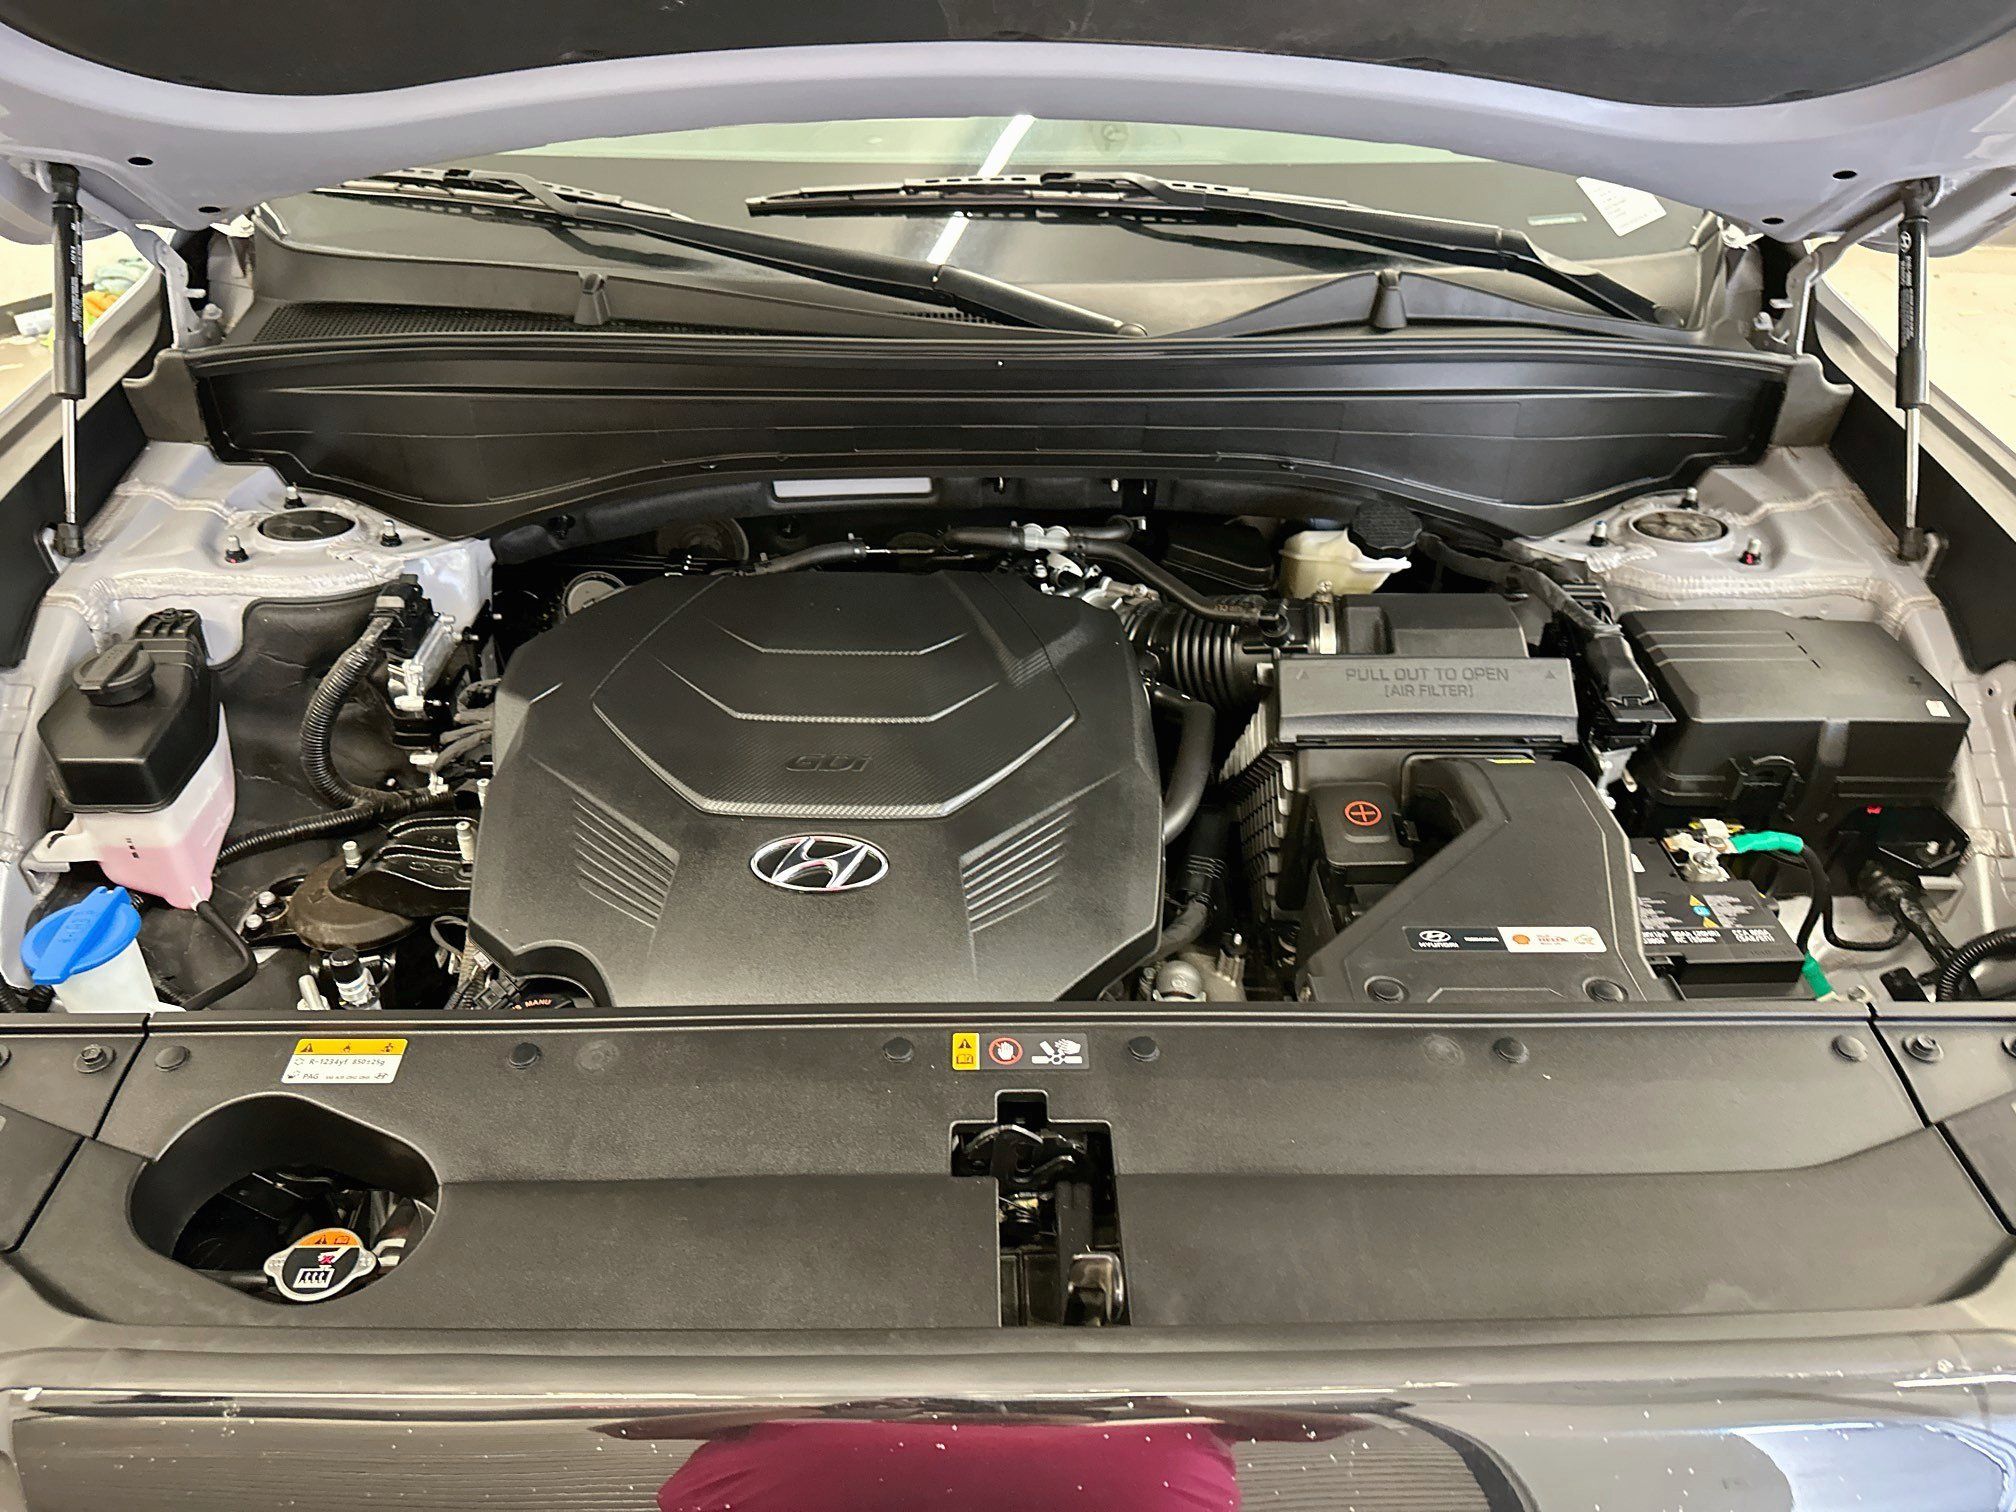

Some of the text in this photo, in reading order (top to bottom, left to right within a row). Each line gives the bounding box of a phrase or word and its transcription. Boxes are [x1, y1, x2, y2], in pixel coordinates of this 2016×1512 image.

[1345, 667, 1509, 681] PULL OUT TO OPEN
[308, 1058, 348, 1067] R-1234yf
